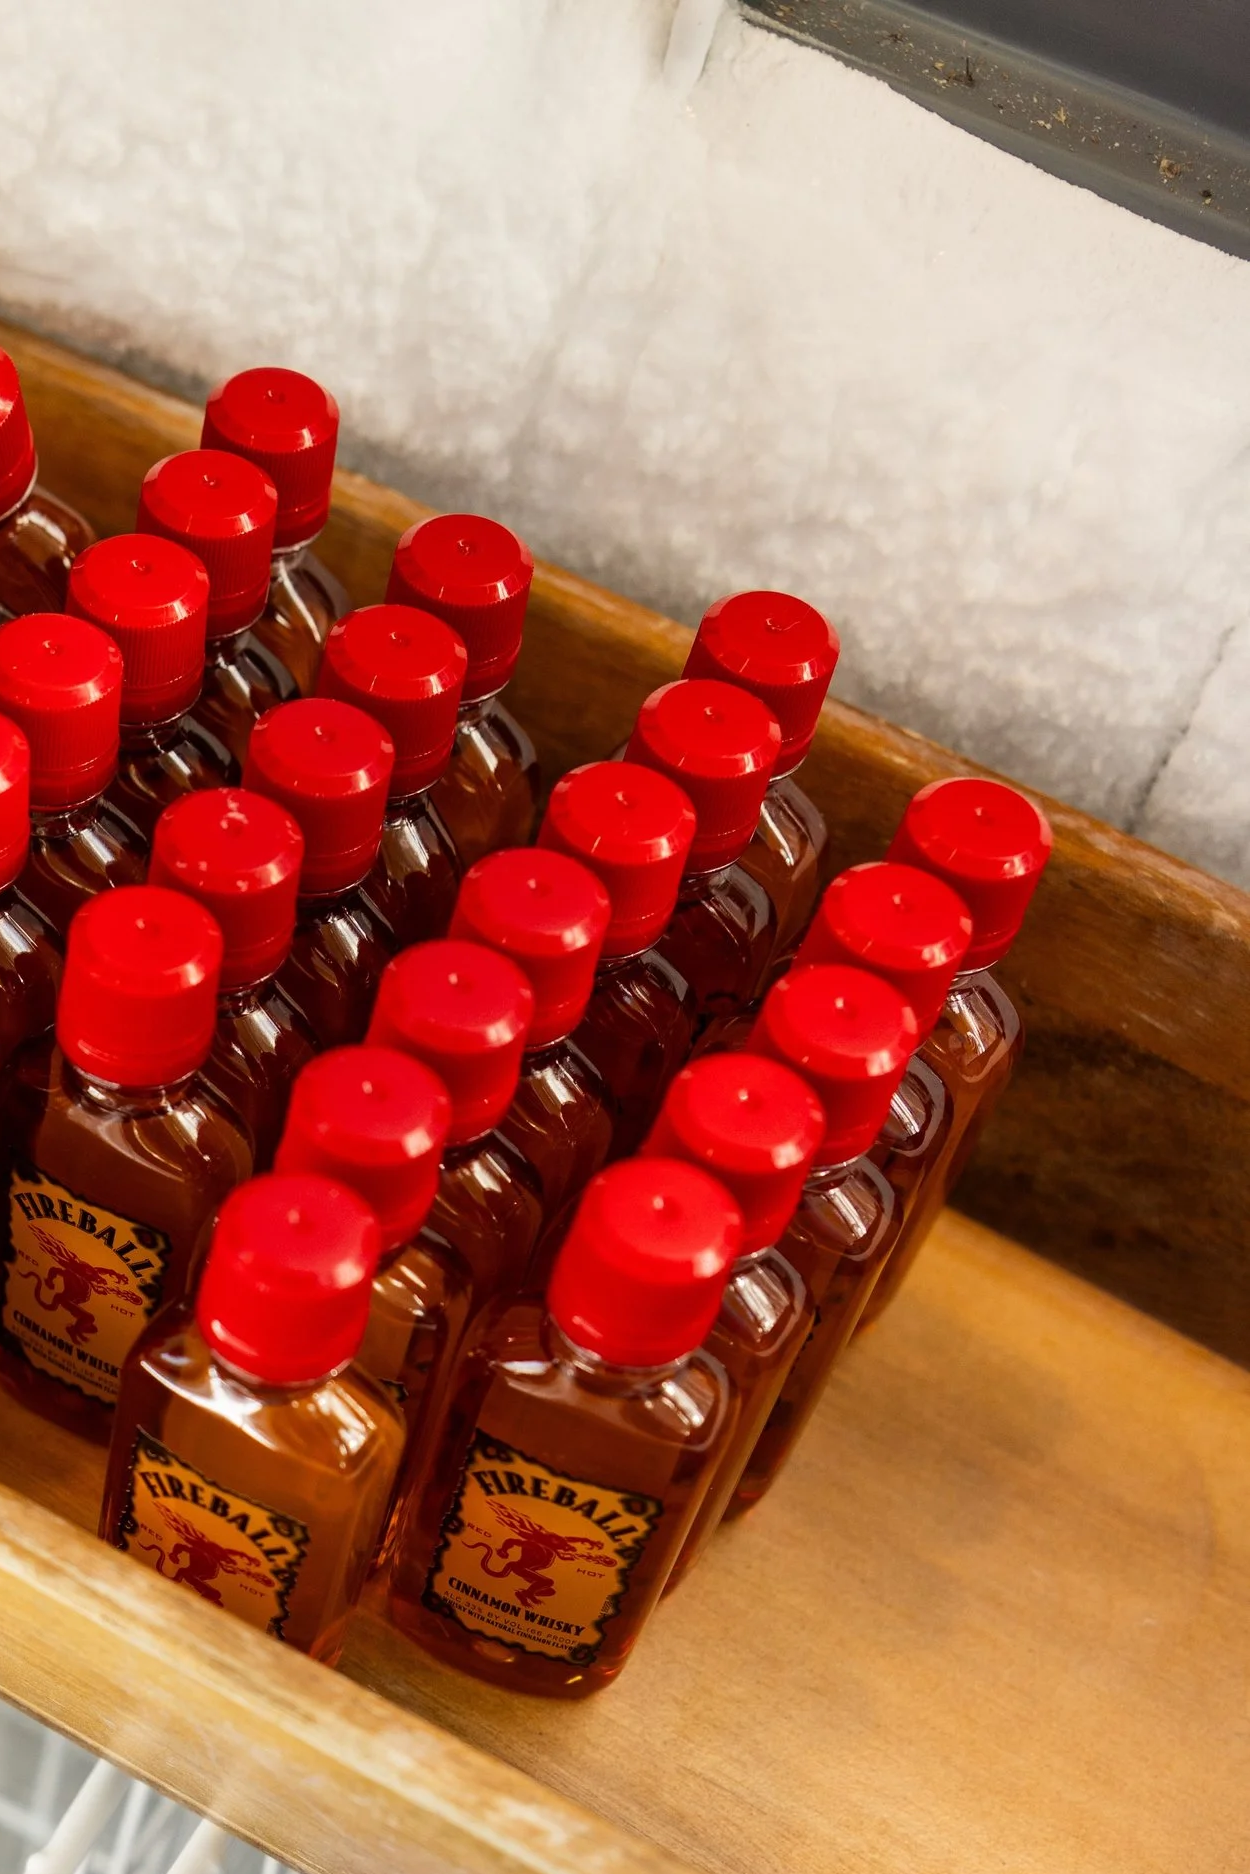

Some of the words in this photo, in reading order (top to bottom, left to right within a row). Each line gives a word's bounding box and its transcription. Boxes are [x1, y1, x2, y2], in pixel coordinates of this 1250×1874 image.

[14, 1192, 154, 1278] FIREBALL
[18, 1249, 39, 1267] RED
[111, 1304, 136, 1317] HOT
[13, 1310, 73, 1356] CINNAMON
[76, 1347, 120, 1378] WHISK
[139, 1471, 289, 1563] FIREBALL
[471, 1470, 638, 1546] FIREBALL
[140, 1523, 163, 1541] RED
[467, 1522, 492, 1538] RED
[577, 1567, 605, 1579] HOT
[239, 1583, 265, 1598] HOT
[448, 1577, 521, 1617] CINNAMON
[524, 1609, 586, 1636] WHISKY
[468, 1609, 485, 1621] WITH
[486, 1618, 515, 1634] NATURAL
[516, 1630, 551, 1645] CINNAMON
